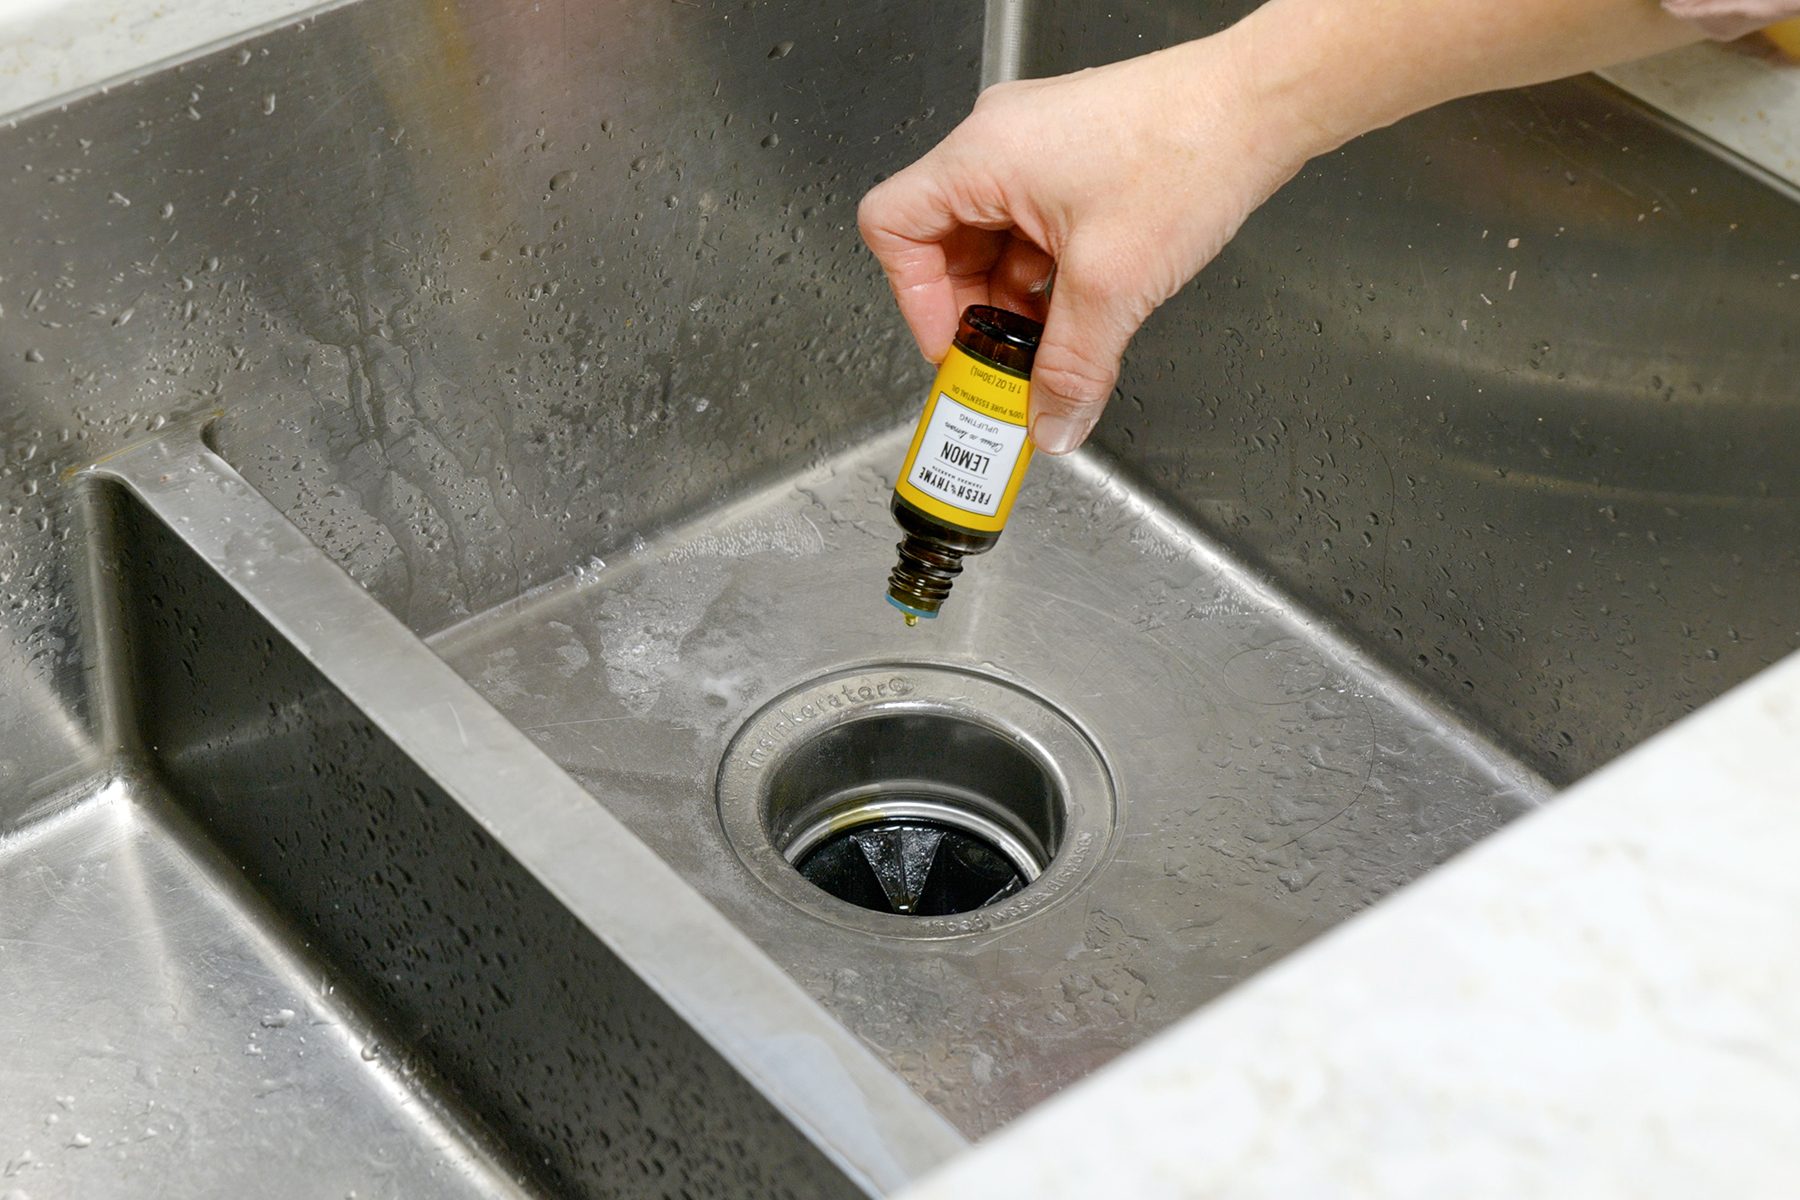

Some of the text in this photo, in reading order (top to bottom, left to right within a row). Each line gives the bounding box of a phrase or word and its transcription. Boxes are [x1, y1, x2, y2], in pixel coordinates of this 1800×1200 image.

[970, 365, 1021, 394] 1 FL OZ (30mL)
[951, 384, 1025, 420] 100% PURE ESSENTIAL OIL
[959, 413, 999, 434] UPLIFTING
[940, 441, 990, 474] LEMON
[919, 467, 992, 505] FRESH THYME
